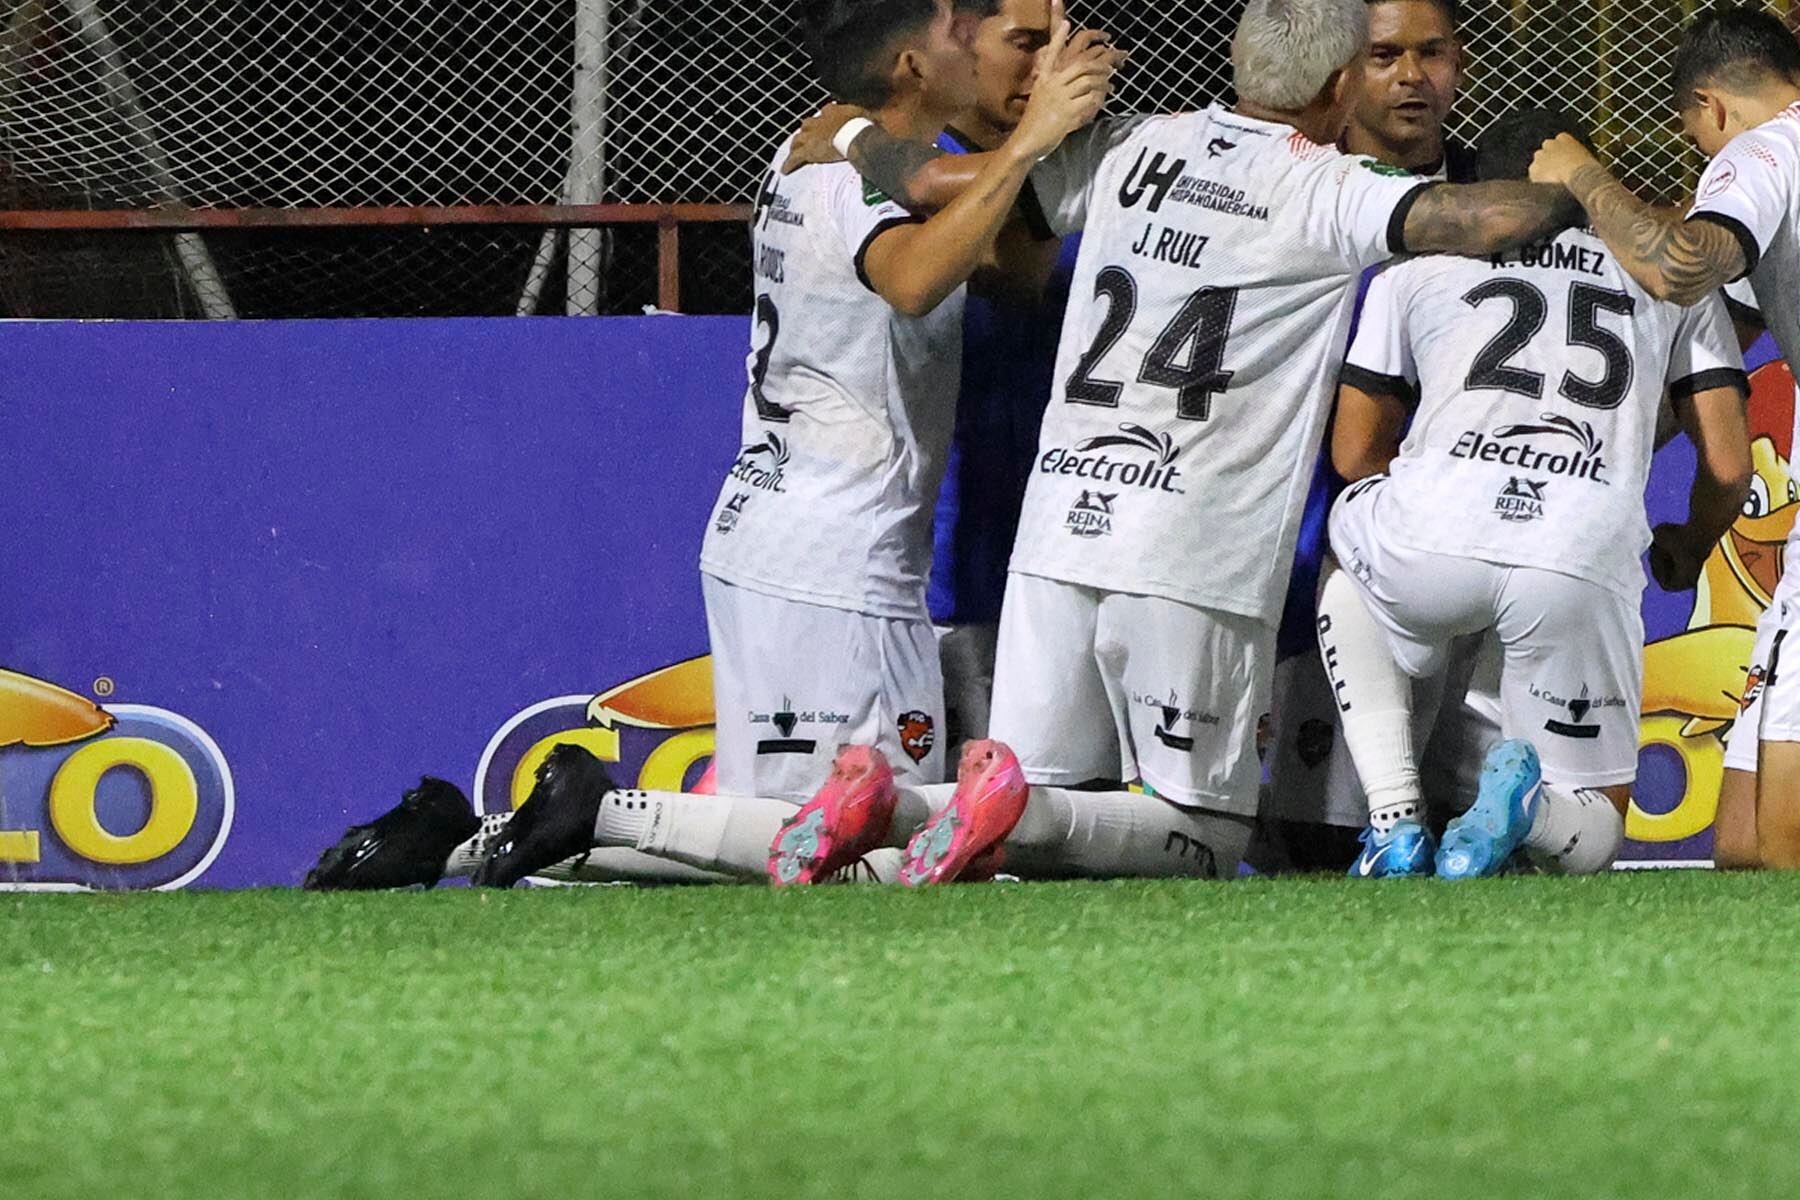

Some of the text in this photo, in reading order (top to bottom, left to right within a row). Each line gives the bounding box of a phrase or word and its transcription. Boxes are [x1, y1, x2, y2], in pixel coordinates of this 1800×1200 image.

[1132, 223, 1209, 269] J. RUIZ
[1065, 266, 1239, 422] 24
[1460, 276, 1636, 410] 25
[1041, 448, 1183, 493] Electrolit
[1449, 430, 1606, 483] Electrolit
[1066, 511, 1113, 531] REINA
[1494, 497, 1544, 516] REINA
[800, 712, 815, 723] del
[818, 712, 850, 724] Sabor
